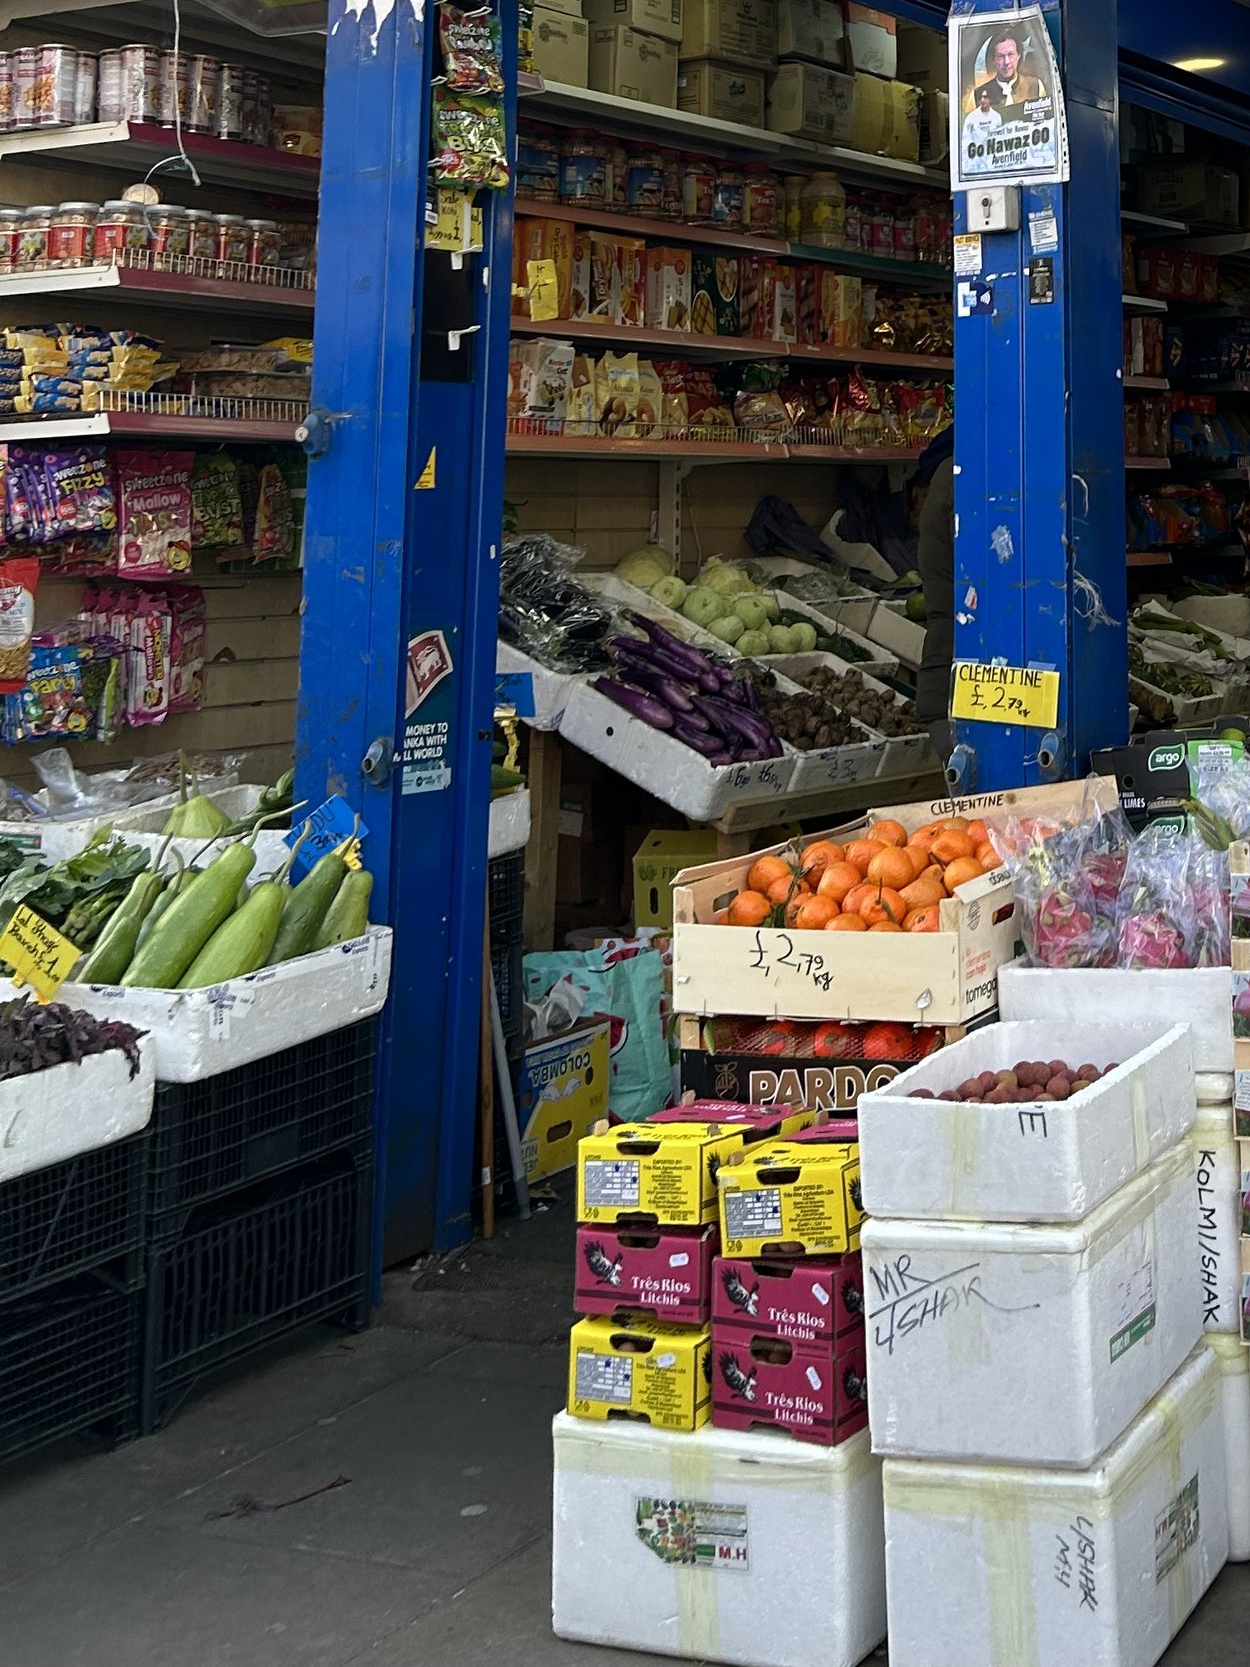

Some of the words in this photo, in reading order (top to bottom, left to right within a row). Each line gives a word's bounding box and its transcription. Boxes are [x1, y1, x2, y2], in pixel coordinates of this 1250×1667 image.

[967, 142, 985, 159] Go
[986, 134, 1030, 156] Nawaz
[992, 149, 1027, 165] Avenfield
[132, 492, 182, 511] Mallow
[958, 663, 1043, 688] CLEMENTINE
[405, 722, 436, 736] MONEY
[437, 722, 448, 733] TO
[426, 734, 447, 746] WITH
[413, 746, 443, 759] WORLD
[1154, 750, 1180, 765] argo
[930, 793, 1004, 817] CLEMENTINE
[1123, 797, 1146, 809] LIMES
[529, 1051, 591, 1088] COLOMBA
[631, 1275, 659, 1293] Três
[661, 1276, 691, 1293] Rios
[640, 1290, 680, 1306] Litchis
[768, 1307, 796, 1325] Três
[797, 1310, 825, 1328] Rios
[776, 1323, 816, 1340] Litchis
[765, 1392, 793, 1409] Três
[795, 1395, 825, 1414] Rios
[775, 1408, 814, 1426] Litchis
